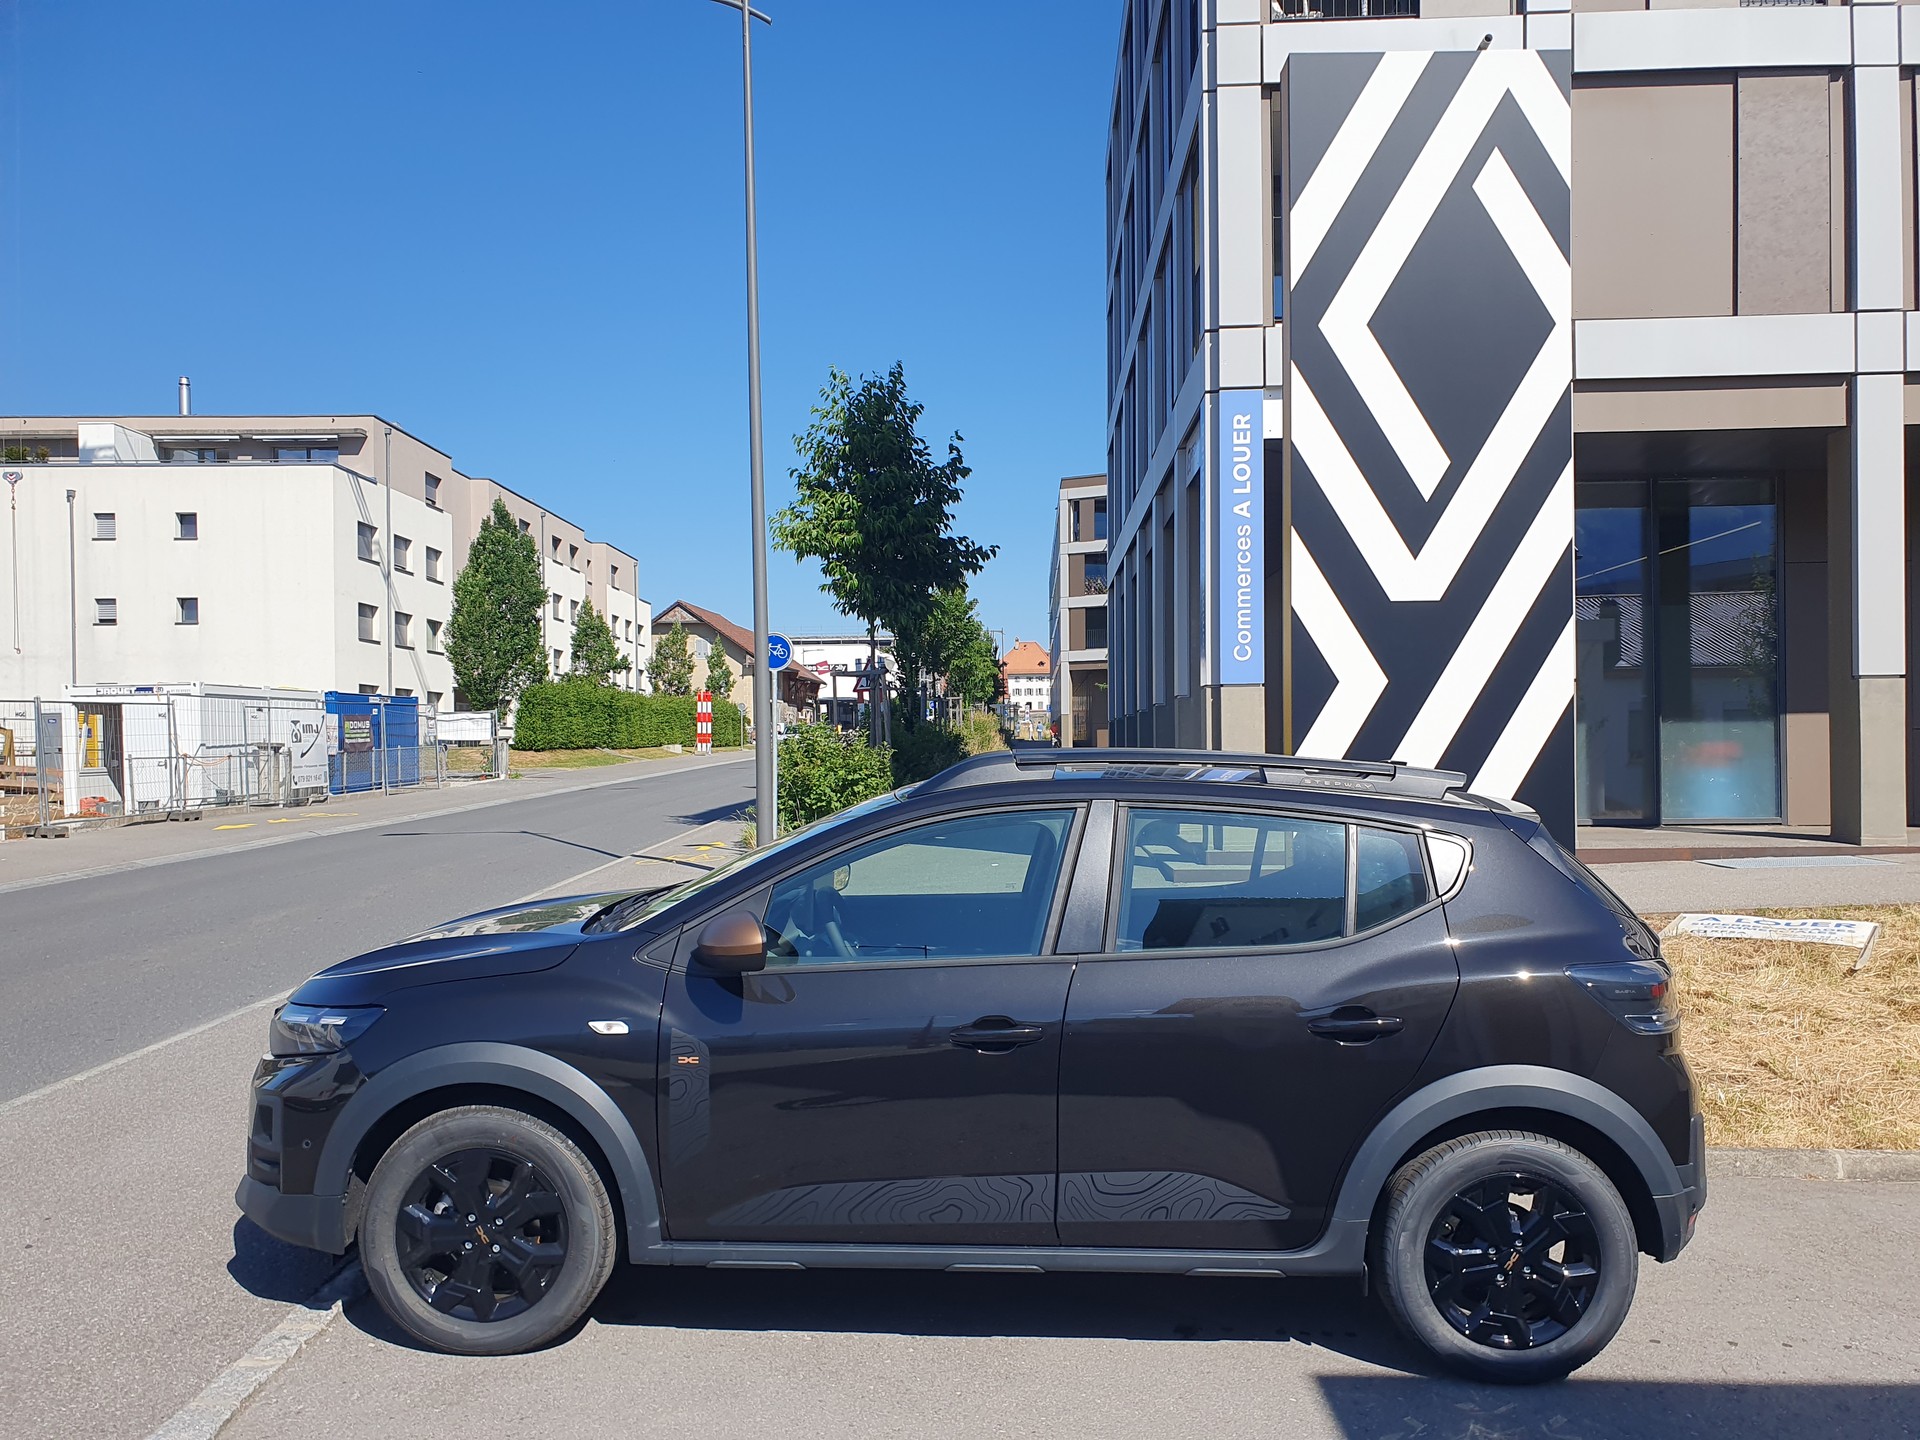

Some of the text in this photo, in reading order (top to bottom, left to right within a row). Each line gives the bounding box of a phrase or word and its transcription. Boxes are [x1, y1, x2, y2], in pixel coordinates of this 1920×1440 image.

[1232, 413, 1252, 662] Commerces A LOUER
[349, 720, 370, 729] DOMUS
[1304, 779, 1372, 788] STEPWAY
[1735, 917, 1857, 928] LOUER
